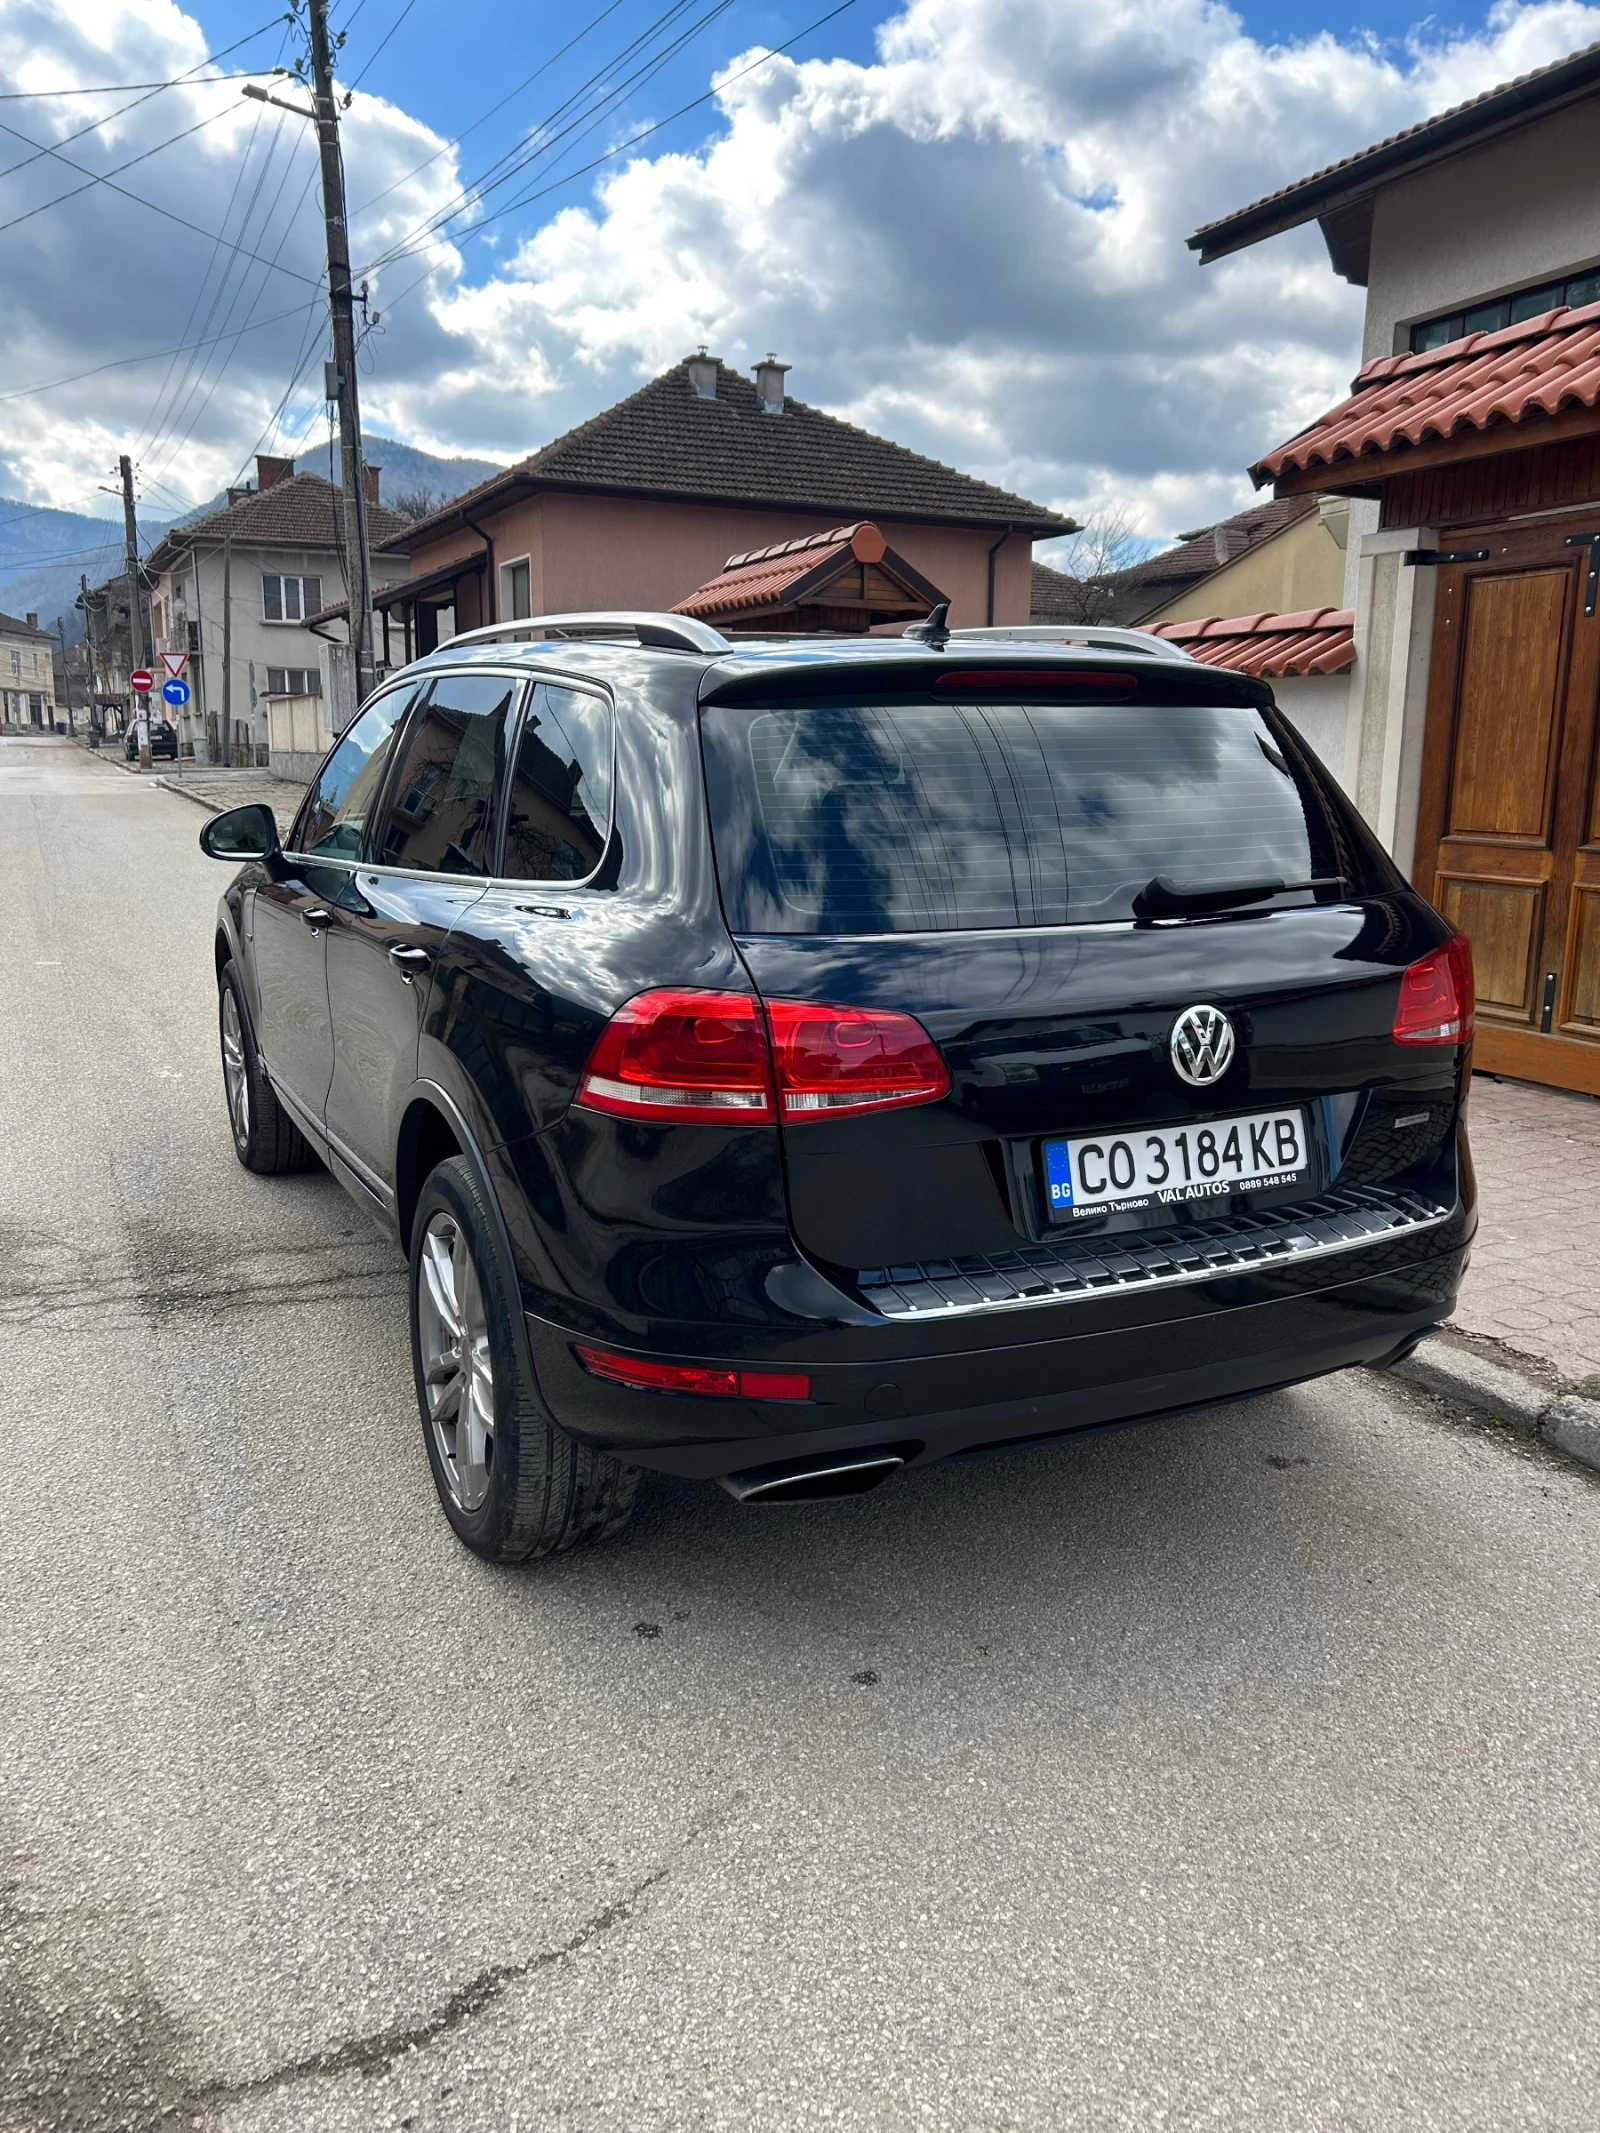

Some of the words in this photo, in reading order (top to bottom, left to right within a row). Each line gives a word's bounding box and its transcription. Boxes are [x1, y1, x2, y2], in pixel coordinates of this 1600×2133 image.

[1051, 1182, 1071, 1200] BG
[1239, 1179, 1262, 1191] 0889
[1263, 1175, 1280, 1187] 548
[1281, 1172, 1297, 1184] 545
[1072, 1204, 1108, 1218] Велико
[1108, 1198, 1149, 1212] Търново
